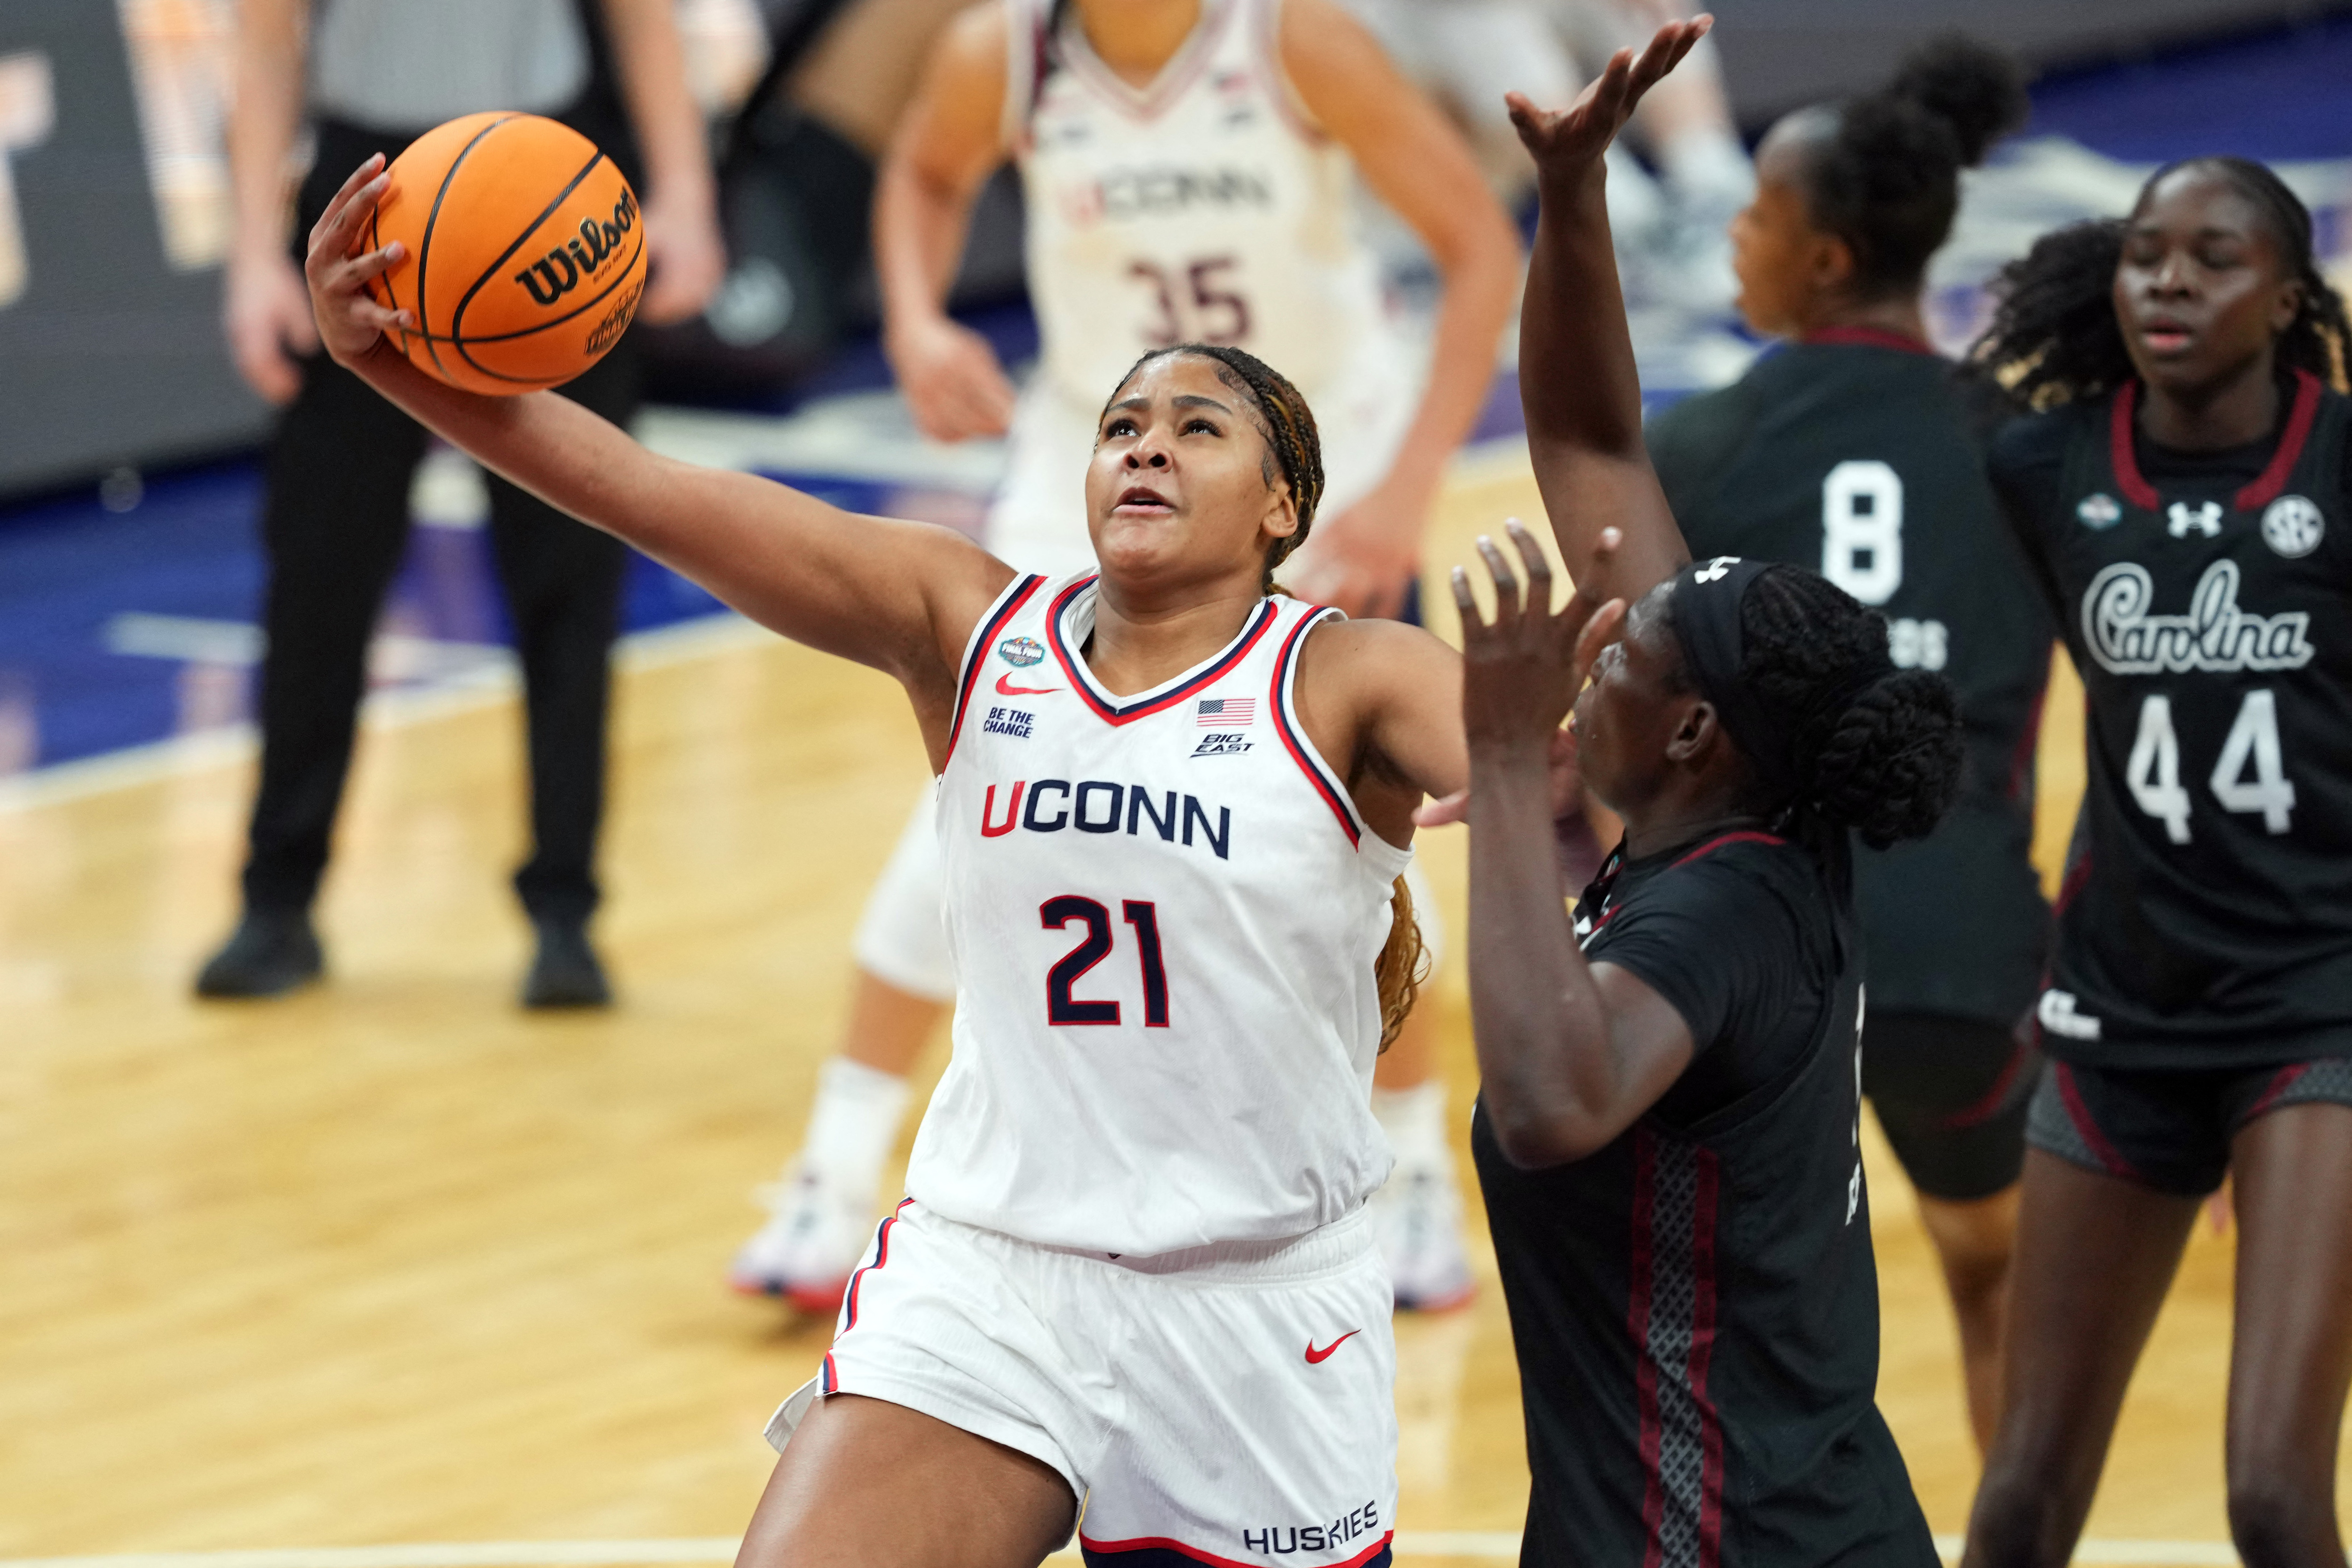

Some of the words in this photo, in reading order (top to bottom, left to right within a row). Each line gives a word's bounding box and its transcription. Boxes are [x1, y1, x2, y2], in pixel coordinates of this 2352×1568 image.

[1127, 255, 1253, 347] 35
[1821, 459, 1903, 605] 8
[2081, 558, 2315, 675] Carolina
[1001, 643, 1023, 655] FINAL
[1022, 647, 1043, 659] FOUR
[984, 720, 1033, 739] CHANGE
[989, 707, 1007, 720] BE
[1009, 709, 1035, 725] THE
[1195, 743, 1255, 752] EAST
[1203, 734, 1245, 743] BIG
[2126, 688, 2296, 845] 44
[981, 780, 1230, 860] UCONN
[1040, 894, 1169, 1027] 21
[1243, 1499, 1378, 1554] HUSKIES
